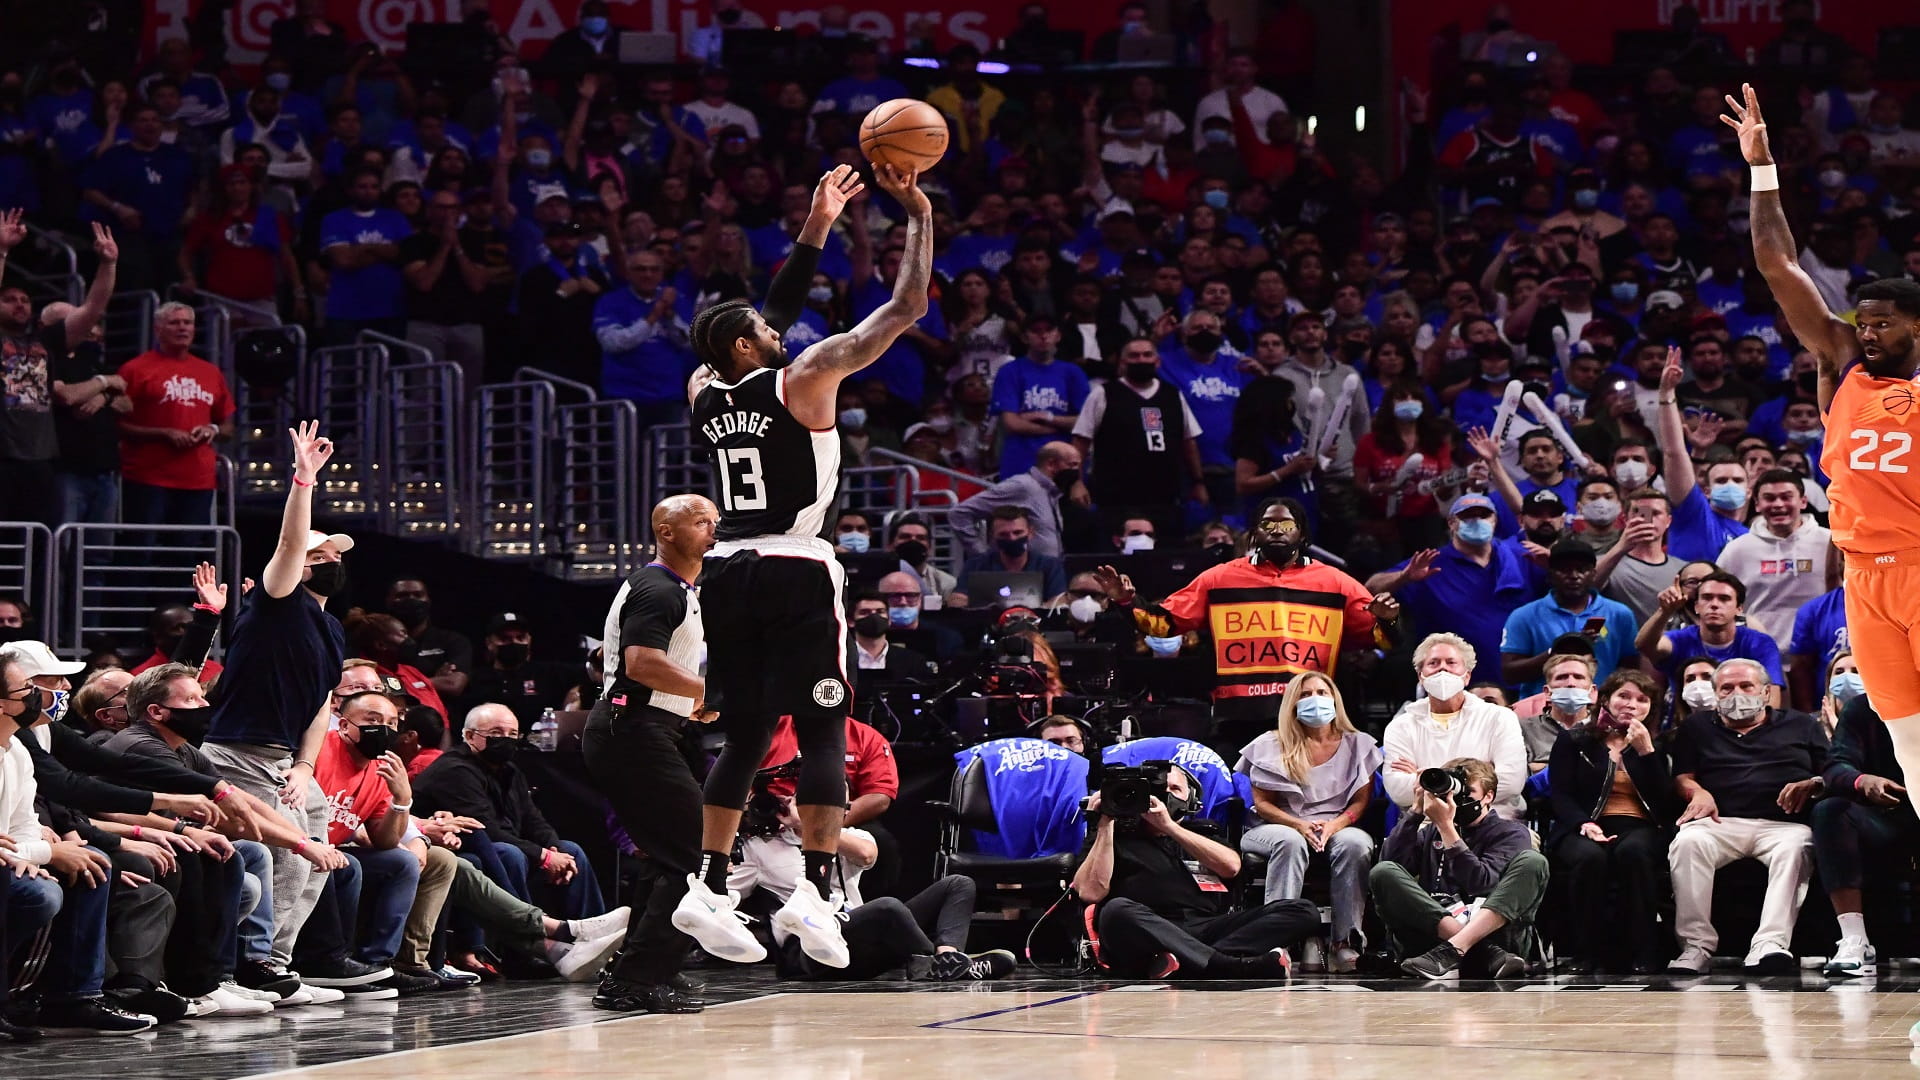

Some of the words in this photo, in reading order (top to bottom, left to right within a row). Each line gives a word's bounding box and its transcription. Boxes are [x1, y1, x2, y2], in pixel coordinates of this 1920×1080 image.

[702, 411, 774, 444] GEORGE
[1146, 430, 1166, 452] 13
[1849, 428, 1913, 474] 22
[717, 447, 767, 511] 13
[1874, 555, 1896, 565] PHX
[1225, 610, 1329, 637] BALEN
[1225, 641, 1321, 668] CIAGA
[995, 743, 1069, 777] Angeles
